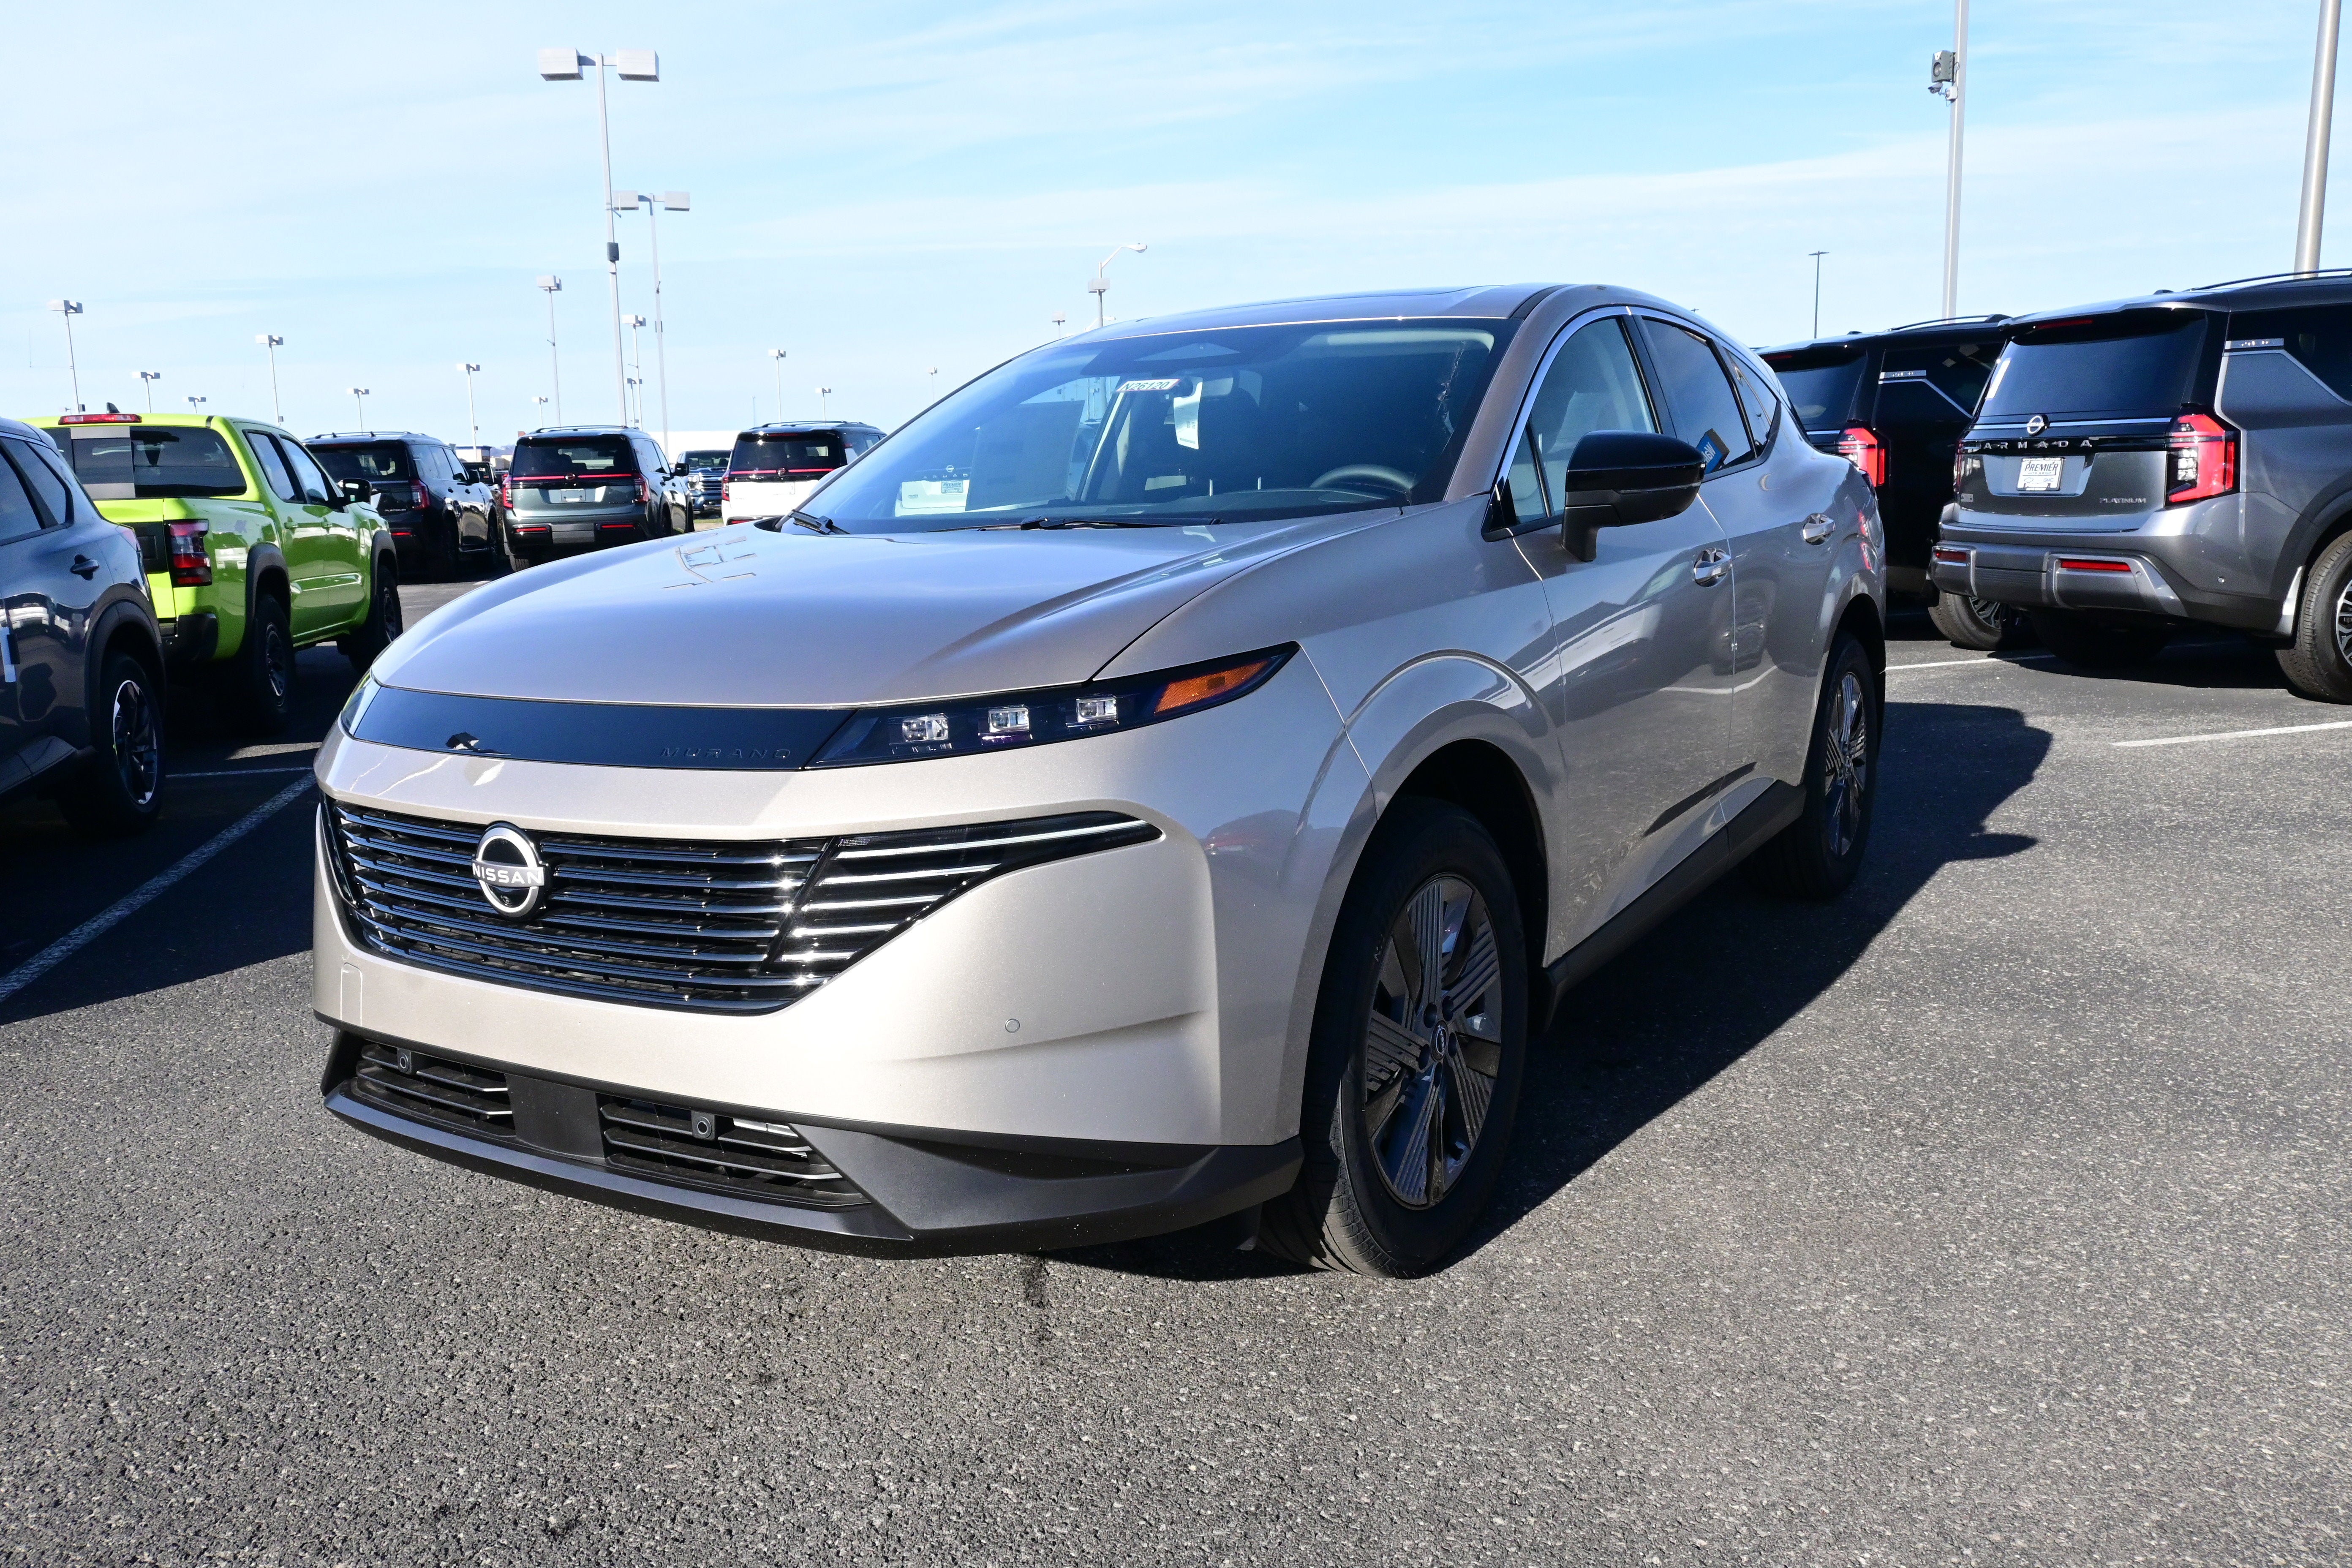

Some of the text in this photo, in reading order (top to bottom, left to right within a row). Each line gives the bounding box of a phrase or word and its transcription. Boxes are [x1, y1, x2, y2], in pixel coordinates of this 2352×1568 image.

[1120, 381, 1170, 391] N26120
[1984, 440, 2092, 449] ARMADA
[2025, 463, 2059, 473] PREMIER
[660, 748, 791, 759] MURANO
[472, 863, 542, 884] NISSAN
